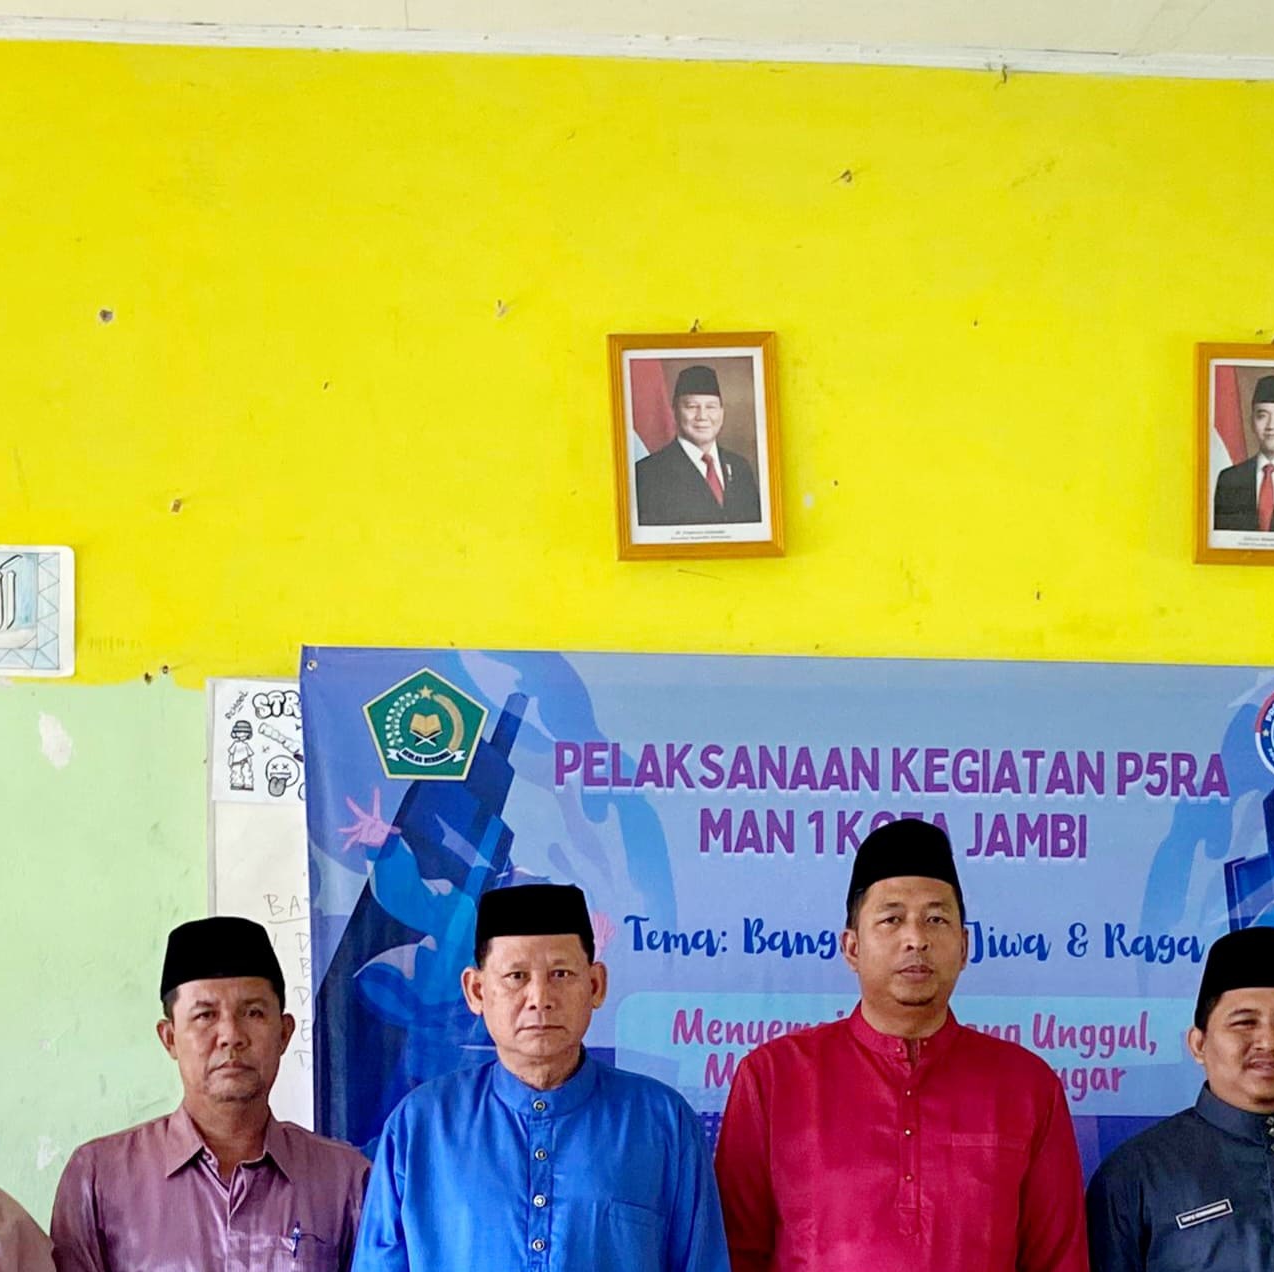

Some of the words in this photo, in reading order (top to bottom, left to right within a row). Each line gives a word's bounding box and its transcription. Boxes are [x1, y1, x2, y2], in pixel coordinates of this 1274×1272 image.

[252, 690, 303, 720] STR
[553, 741, 880, 793] PELAKSANAAN
[891, 747, 1106, 797] KEGIATAN
[1116, 750, 1231, 799] P5RA
[699, 807, 795, 855] MAN
[807, 809, 825, 855] 1
[965, 812, 1087, 859] JAMBI
[623, 914, 728, 958] Tema:
[965, 920, 1052, 964] Jiwa
[1067, 922, 1089, 958] &
[1104, 922, 1206, 964] Raga
[1032, 1010, 1158, 1059] Unggul,
